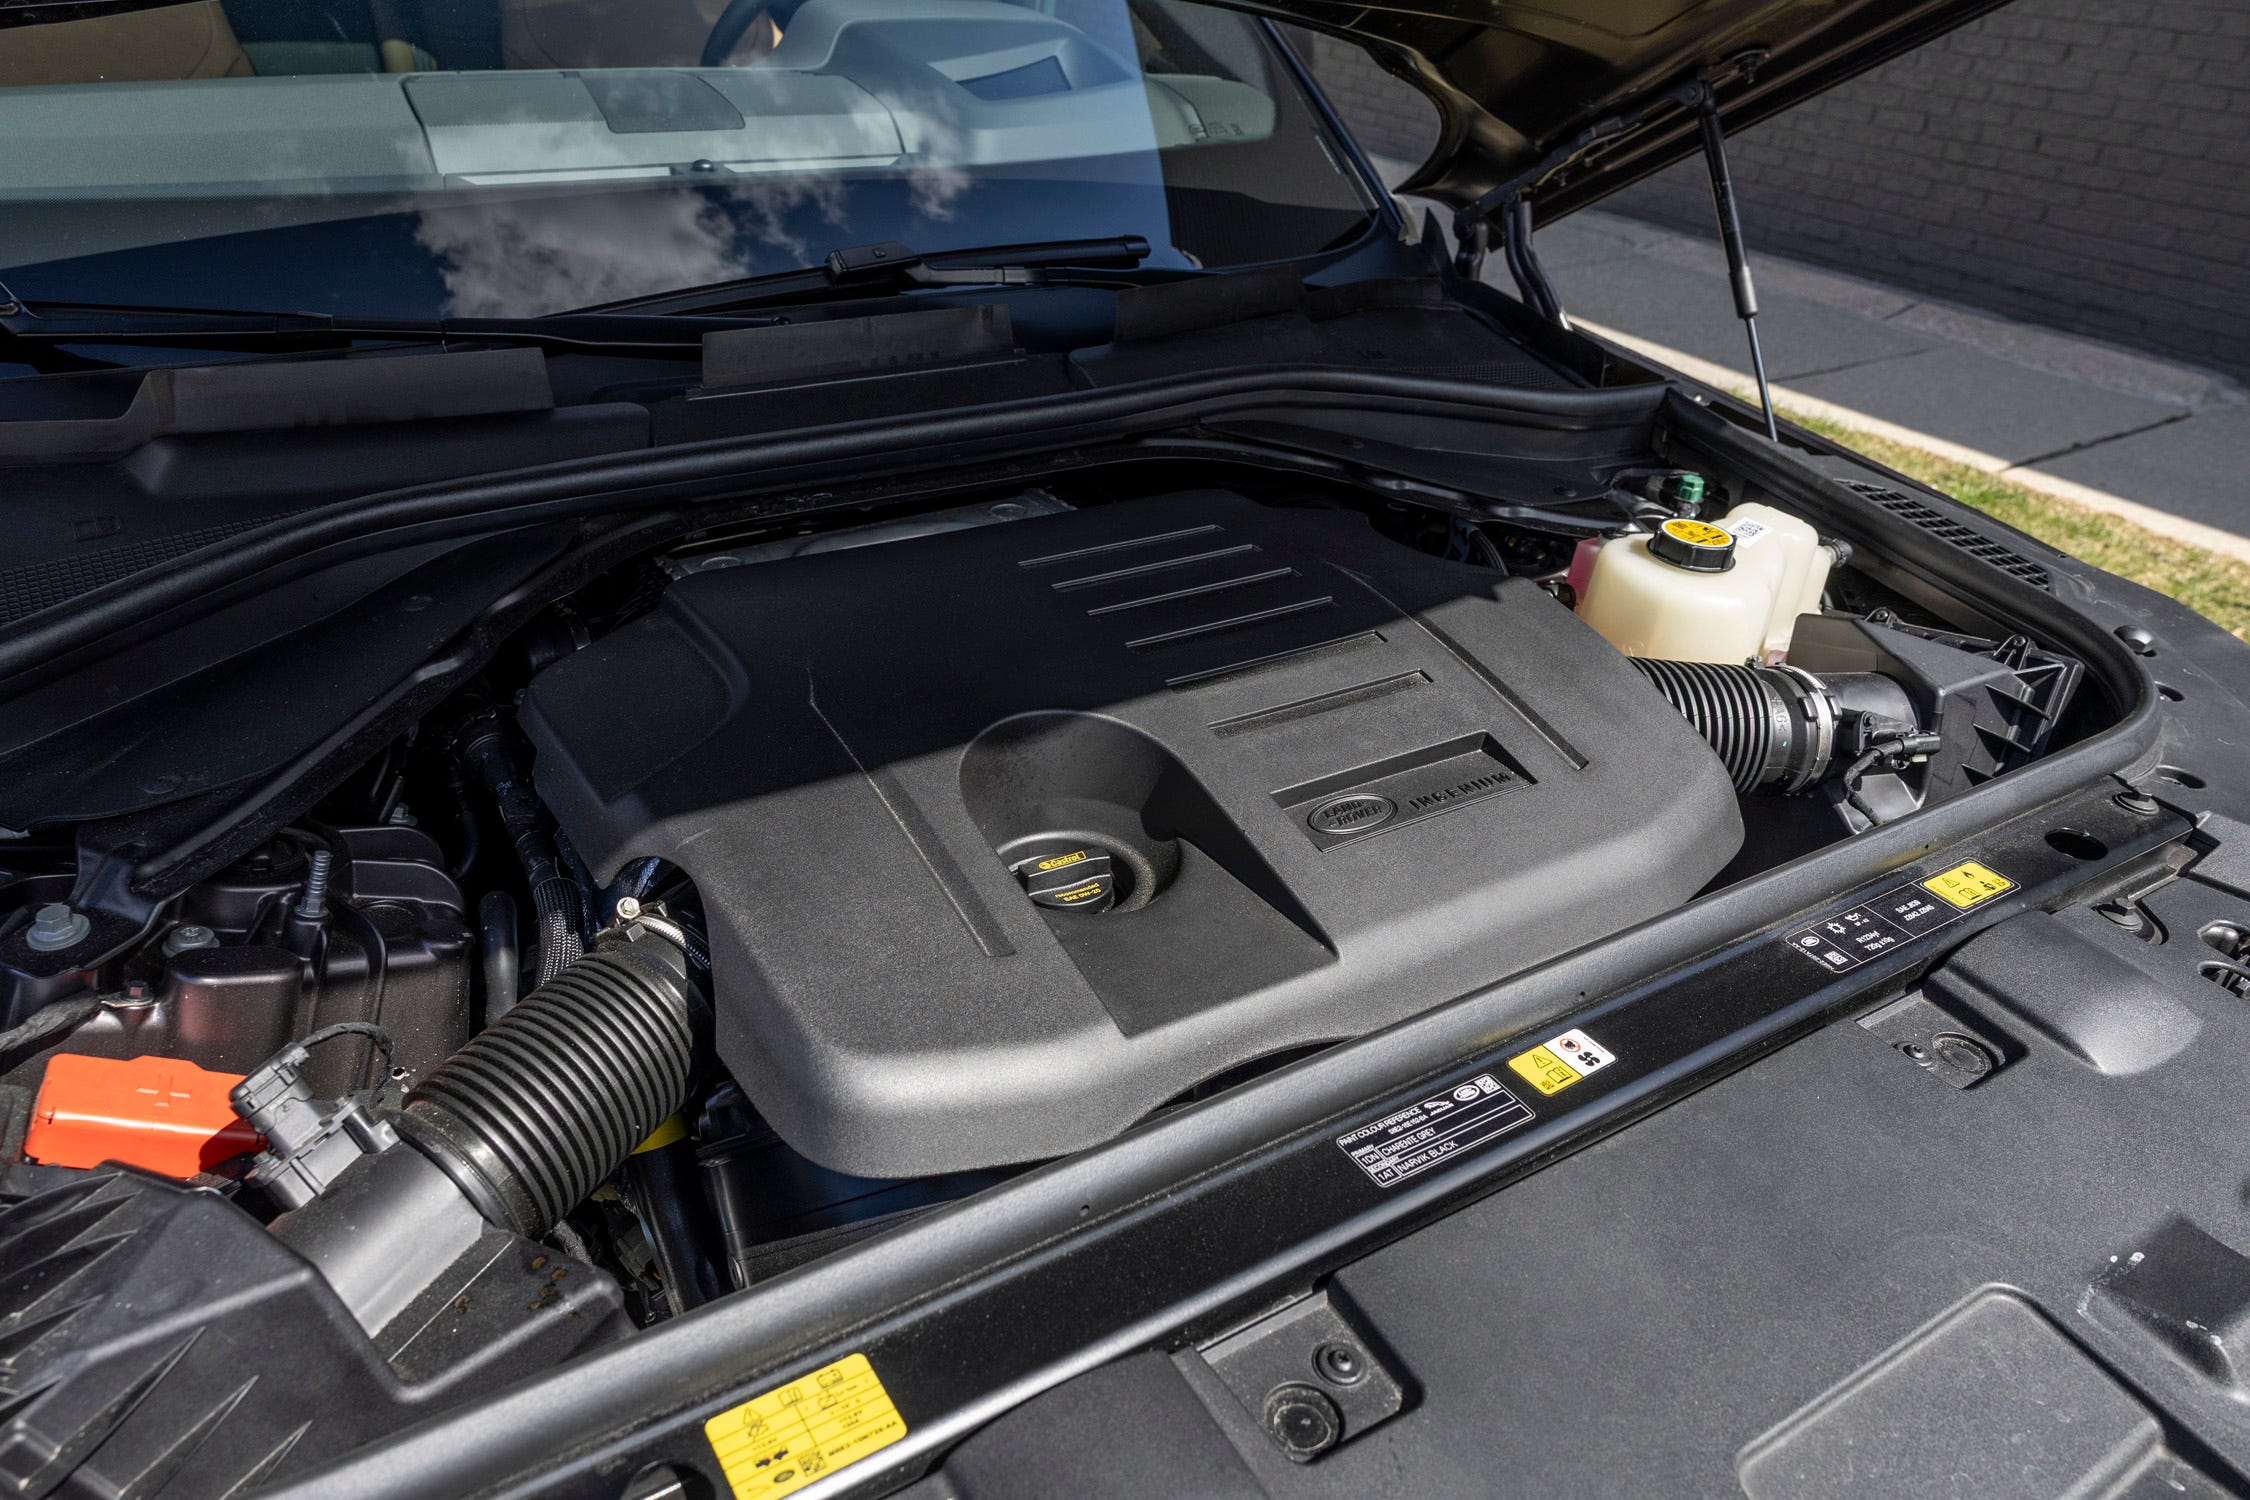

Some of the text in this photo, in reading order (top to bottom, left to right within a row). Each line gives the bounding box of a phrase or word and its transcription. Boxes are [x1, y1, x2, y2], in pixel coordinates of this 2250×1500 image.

[1407, 772, 1513, 811] INGENIUM
[1323, 799, 1365, 819] LAND
[1335, 804, 1383, 827] ROVER
[1050, 855, 1080, 867] Castrol
[1055, 883, 1099, 898] recommended
[1063, 894, 1079, 902] SAE
[1430, 1103, 1454, 1115] JAGUAR
[1339, 1107, 1422, 1146] PAINT COLOUR REFERENCE
[1351, 1143, 1375, 1157] PRIMARY
[1362, 1127, 1436, 1165] 1DN CHARENTE GREY
[1378, 1140, 1459, 1182] 1AT NARVIK BLACK
